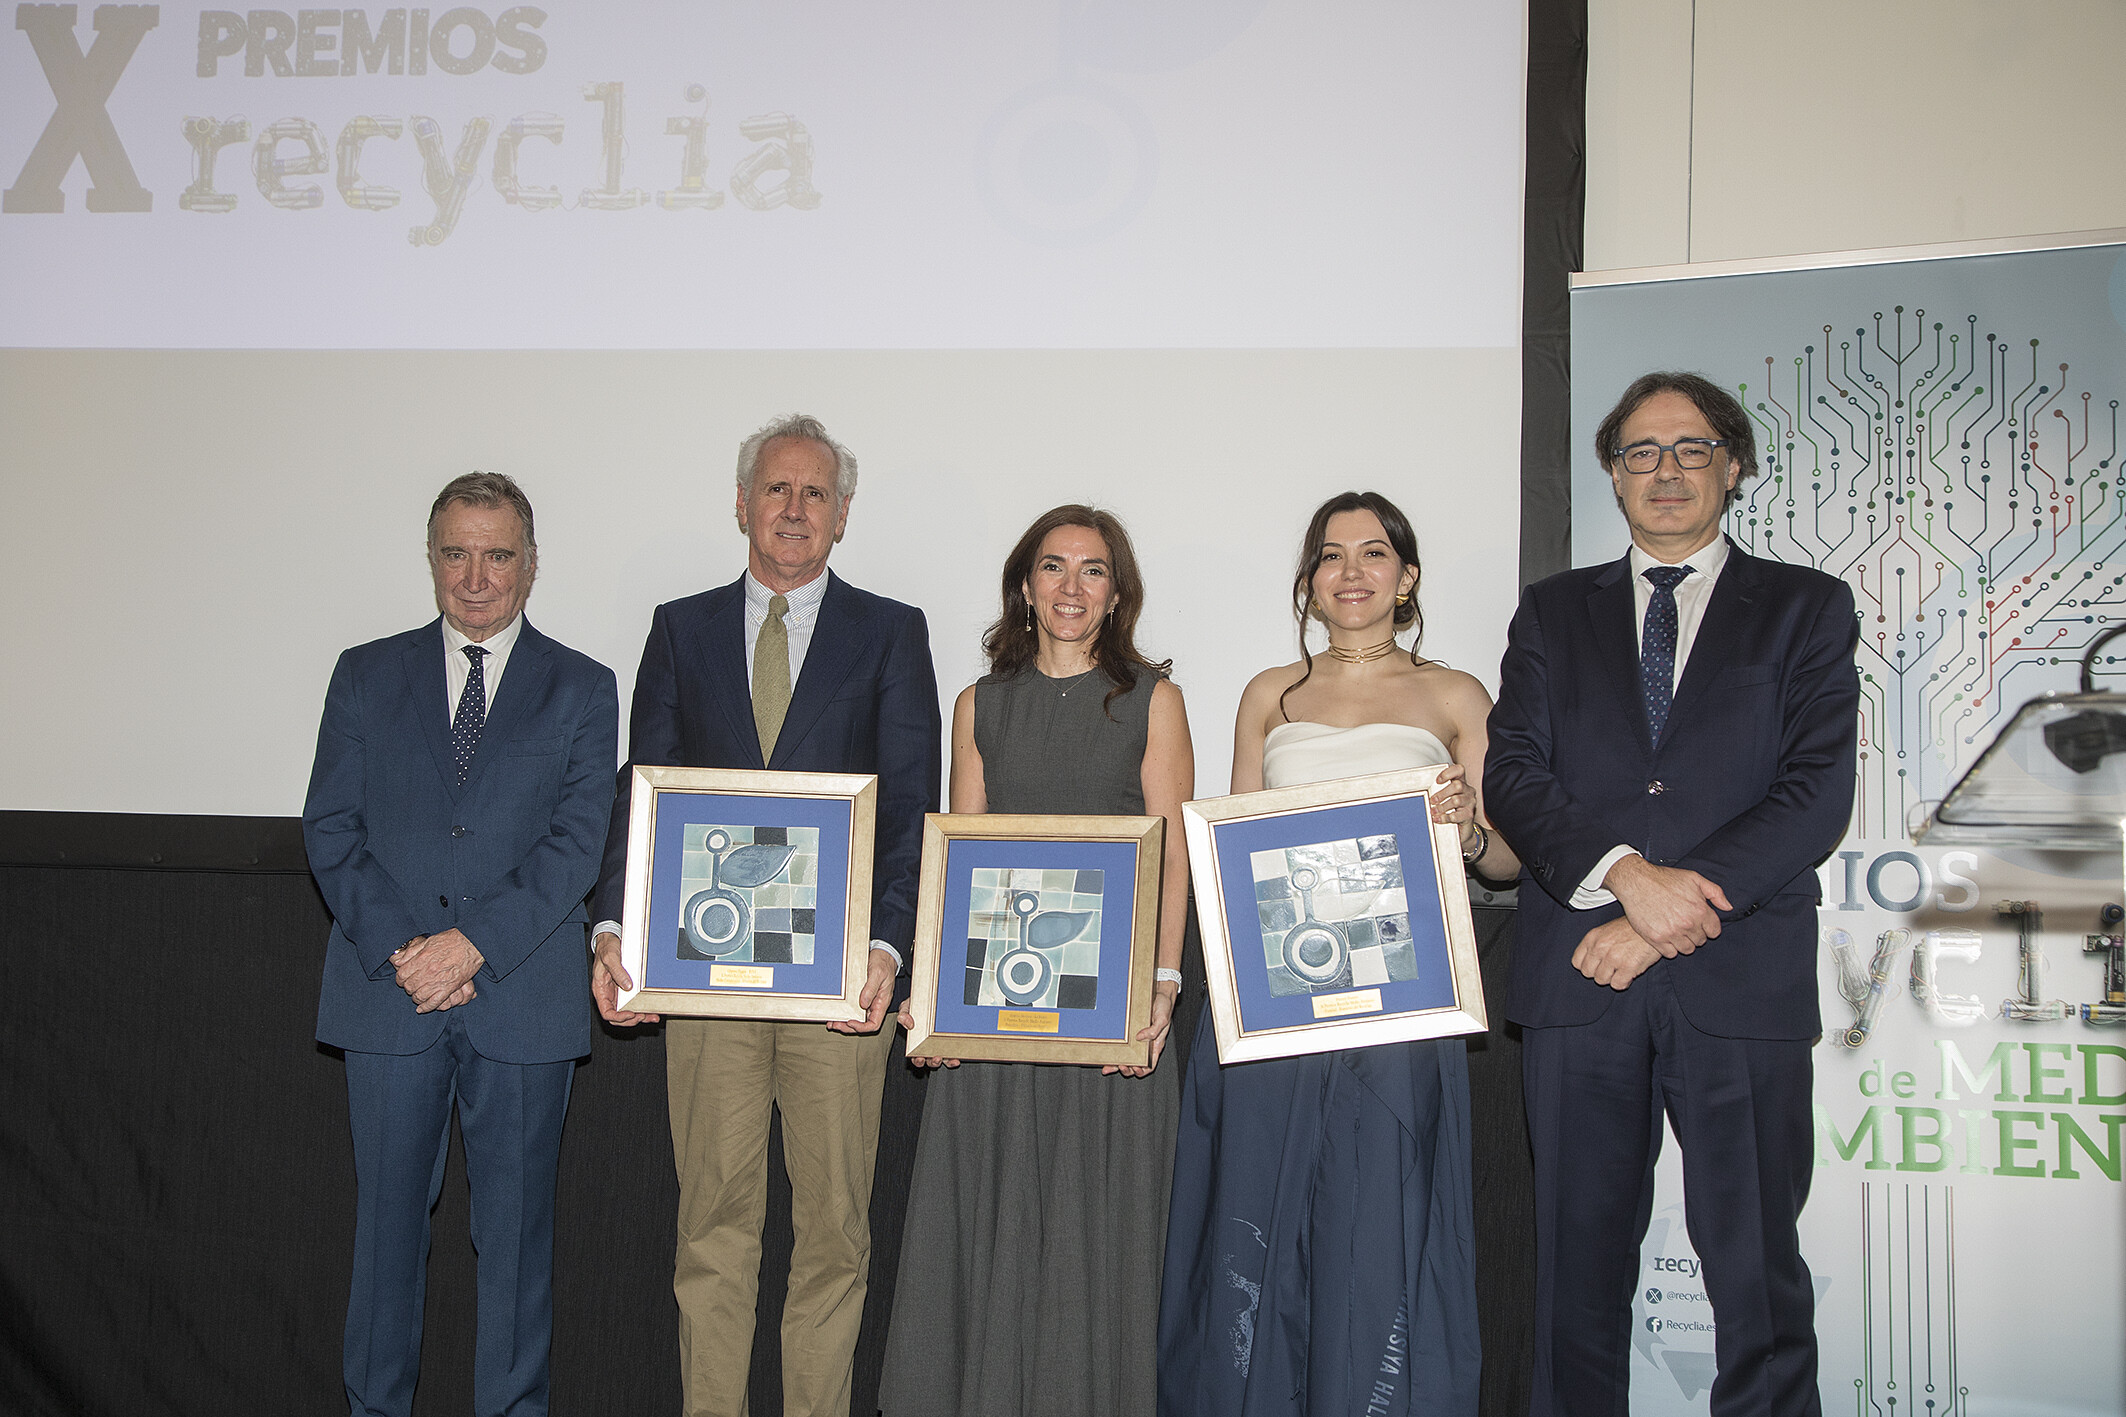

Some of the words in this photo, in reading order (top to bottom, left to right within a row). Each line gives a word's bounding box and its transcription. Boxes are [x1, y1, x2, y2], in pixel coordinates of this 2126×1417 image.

[2, 3, 160, 214] X
[196, 7, 549, 78] PREMIOS
[179, 81, 824, 248] recyclia
[1858, 1059, 1917, 1099] de
[1934, 1039, 2126, 1106] MED
[1654, 1257, 1701, 1278] recy
